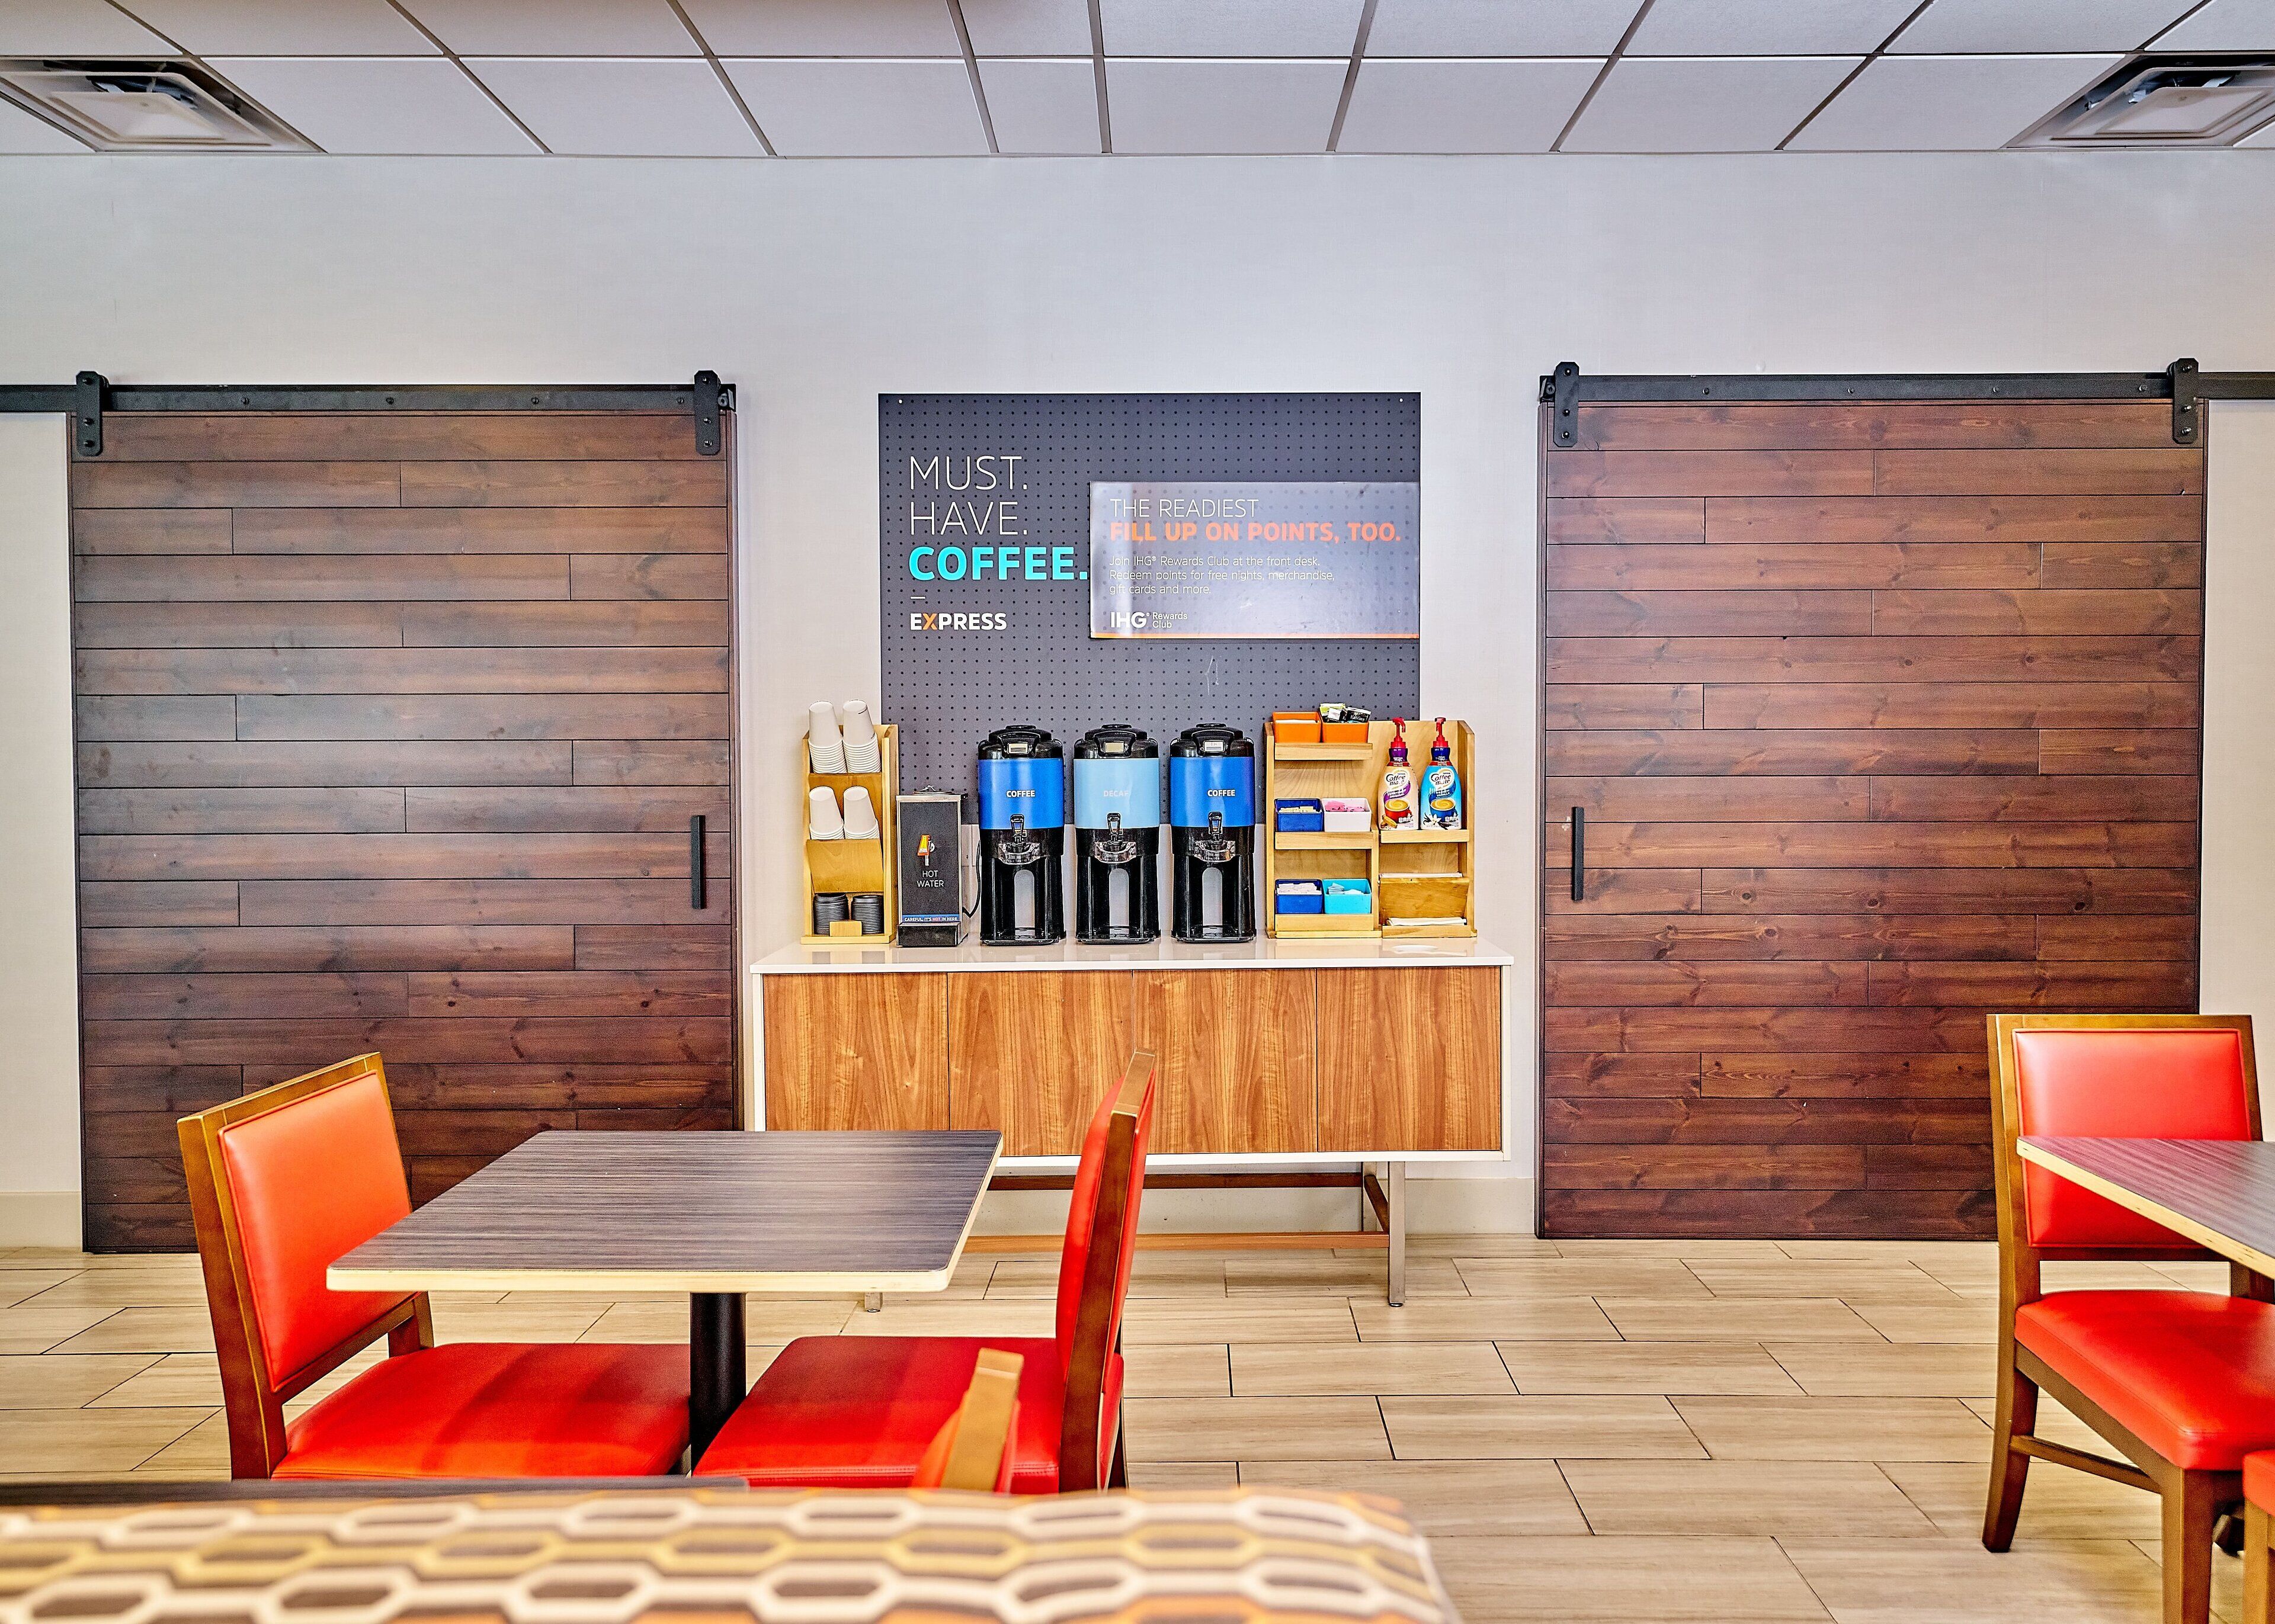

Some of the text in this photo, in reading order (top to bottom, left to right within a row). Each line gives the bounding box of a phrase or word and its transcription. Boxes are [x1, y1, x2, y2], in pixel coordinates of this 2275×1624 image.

[910, 455, 1028, 490] MUST.
[1110, 499, 1259, 518] THE READIEST
[910, 501, 1028, 535] HAVE.
[1110, 522, 1401, 544] FILL UP ON POINTS, TOO.
[909, 546, 1088, 580] COFFEE.
[1109, 556, 1130, 566] Join
[1161, 556, 1204, 566] Rewards
[1207, 556, 1229, 566] Club
[1232, 557, 1243, 566] at
[1246, 556, 1263, 566] the
[1267, 556, 1291, 566] front
[1294, 556, 1321, 566] desk.
[1109, 569, 1335, 582] Redeem points for free nights, merchandise,
[1109, 583, 1212, 594] gift cards and more.
[910, 613, 1007, 630] EXPRESS
[1152, 612, 1188, 620] Rewards
[1152, 620, 1172, 628] Club
[1006, 789, 1036, 798] COFFEE
